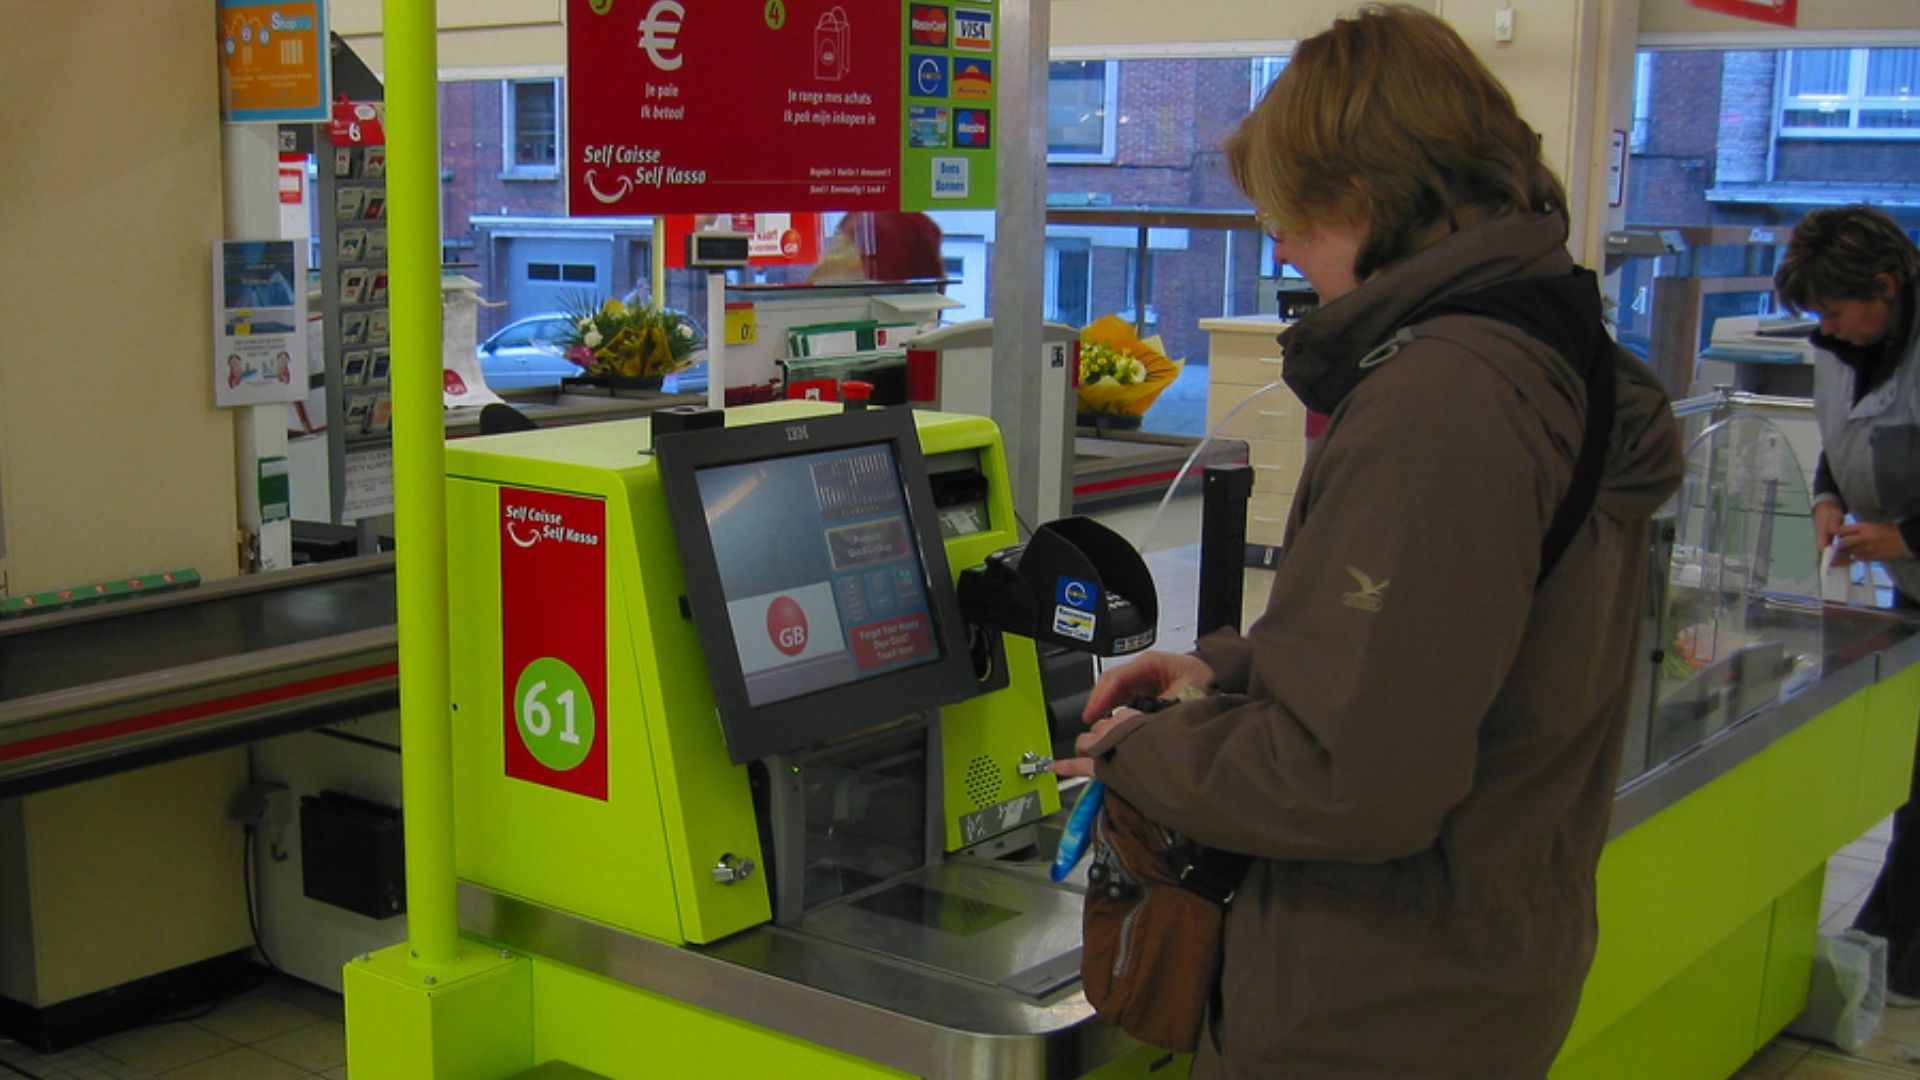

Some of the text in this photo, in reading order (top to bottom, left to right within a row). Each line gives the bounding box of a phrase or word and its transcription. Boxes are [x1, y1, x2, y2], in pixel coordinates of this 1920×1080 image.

[770, 3, 780, 26] 4
[961, 21, 985, 39] VISA
[645, 82, 678, 100] Je paie
[788, 88, 872, 105] Je range mes achats
[641, 104, 651, 119] Ik
[784, 109, 793, 122] Ik
[811, 110, 831, 126] mijn
[832, 111, 866, 127] inkopen
[867, 112, 876, 125] in
[349, 122, 361, 142] 6
[583, 144, 661, 168] Self Caisse
[635, 166, 706, 189] Self Kassa
[941, 161, 960, 174] Bons
[785, 425, 809, 442] IBM
[506, 504, 562, 525] Self Caisse
[543, 524, 598, 545] Self Kassa
[780, 625, 805, 648] GB
[523, 680, 580, 746] 61
